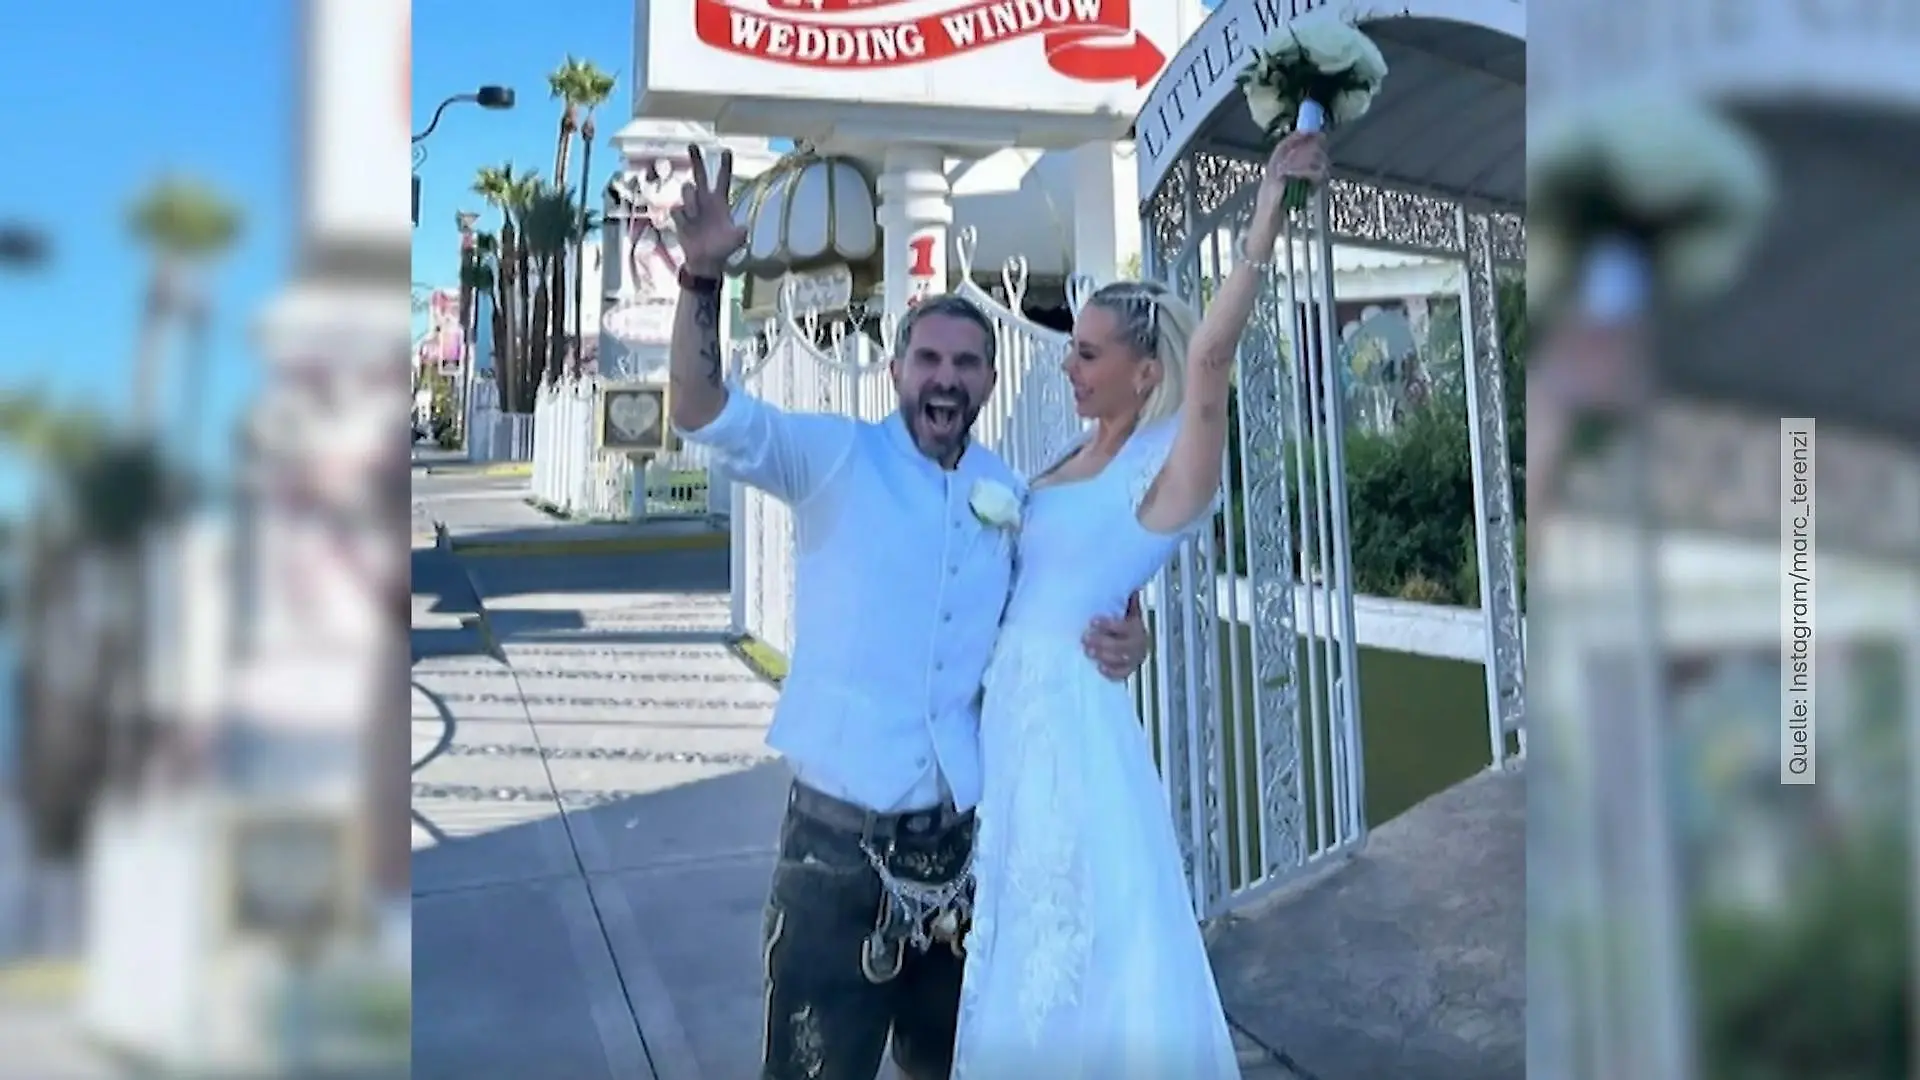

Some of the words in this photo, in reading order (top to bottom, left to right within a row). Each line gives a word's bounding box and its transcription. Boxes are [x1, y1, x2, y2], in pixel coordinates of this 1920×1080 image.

[730, 11, 925, 63] WEDDING
[940, 0, 1100, 48] WINDOW
[1143, 17, 1245, 160] LITTLE
